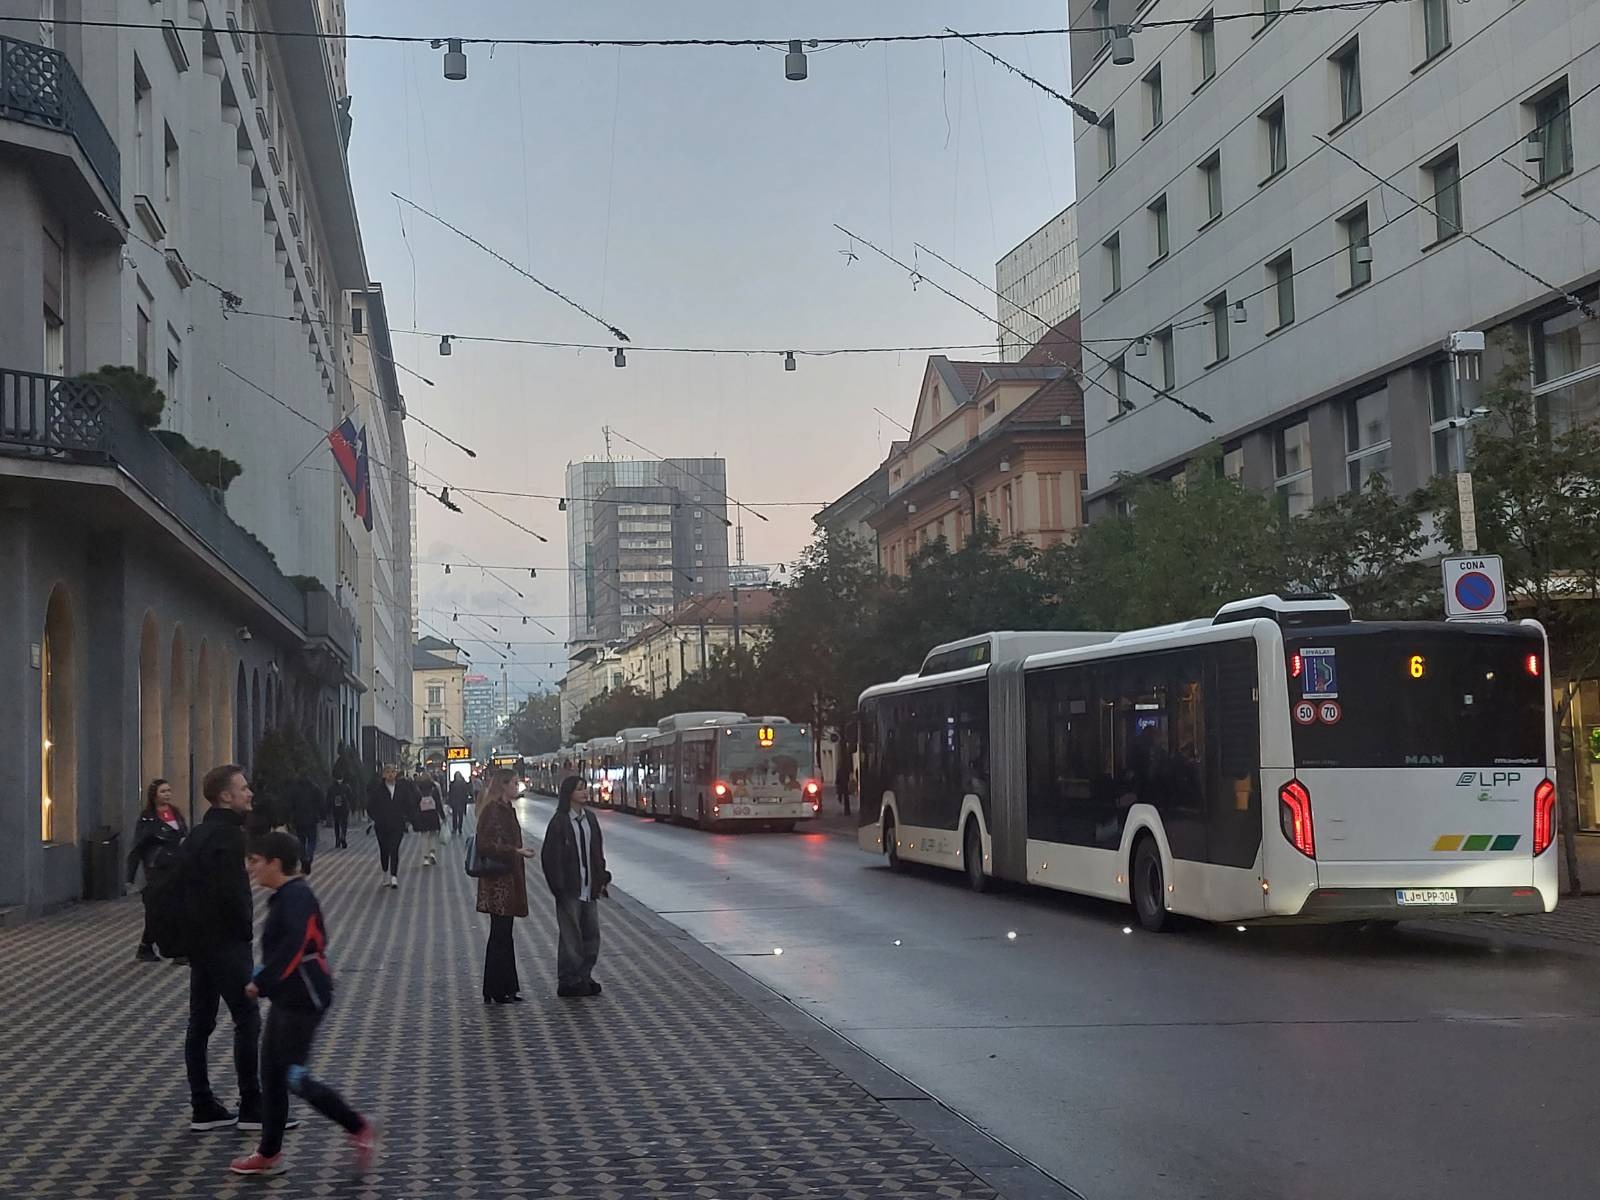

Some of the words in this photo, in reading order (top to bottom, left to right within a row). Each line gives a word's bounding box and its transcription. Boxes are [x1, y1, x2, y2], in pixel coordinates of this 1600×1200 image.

[1460, 561, 1485, 570] CONA
[1411, 655, 1423, 678] 6
[1300, 707, 1312, 719] 50
[1324, 707, 1336, 719] 70
[1405, 755, 1444, 764] MAN
[1480, 772, 1521, 786] LPP
